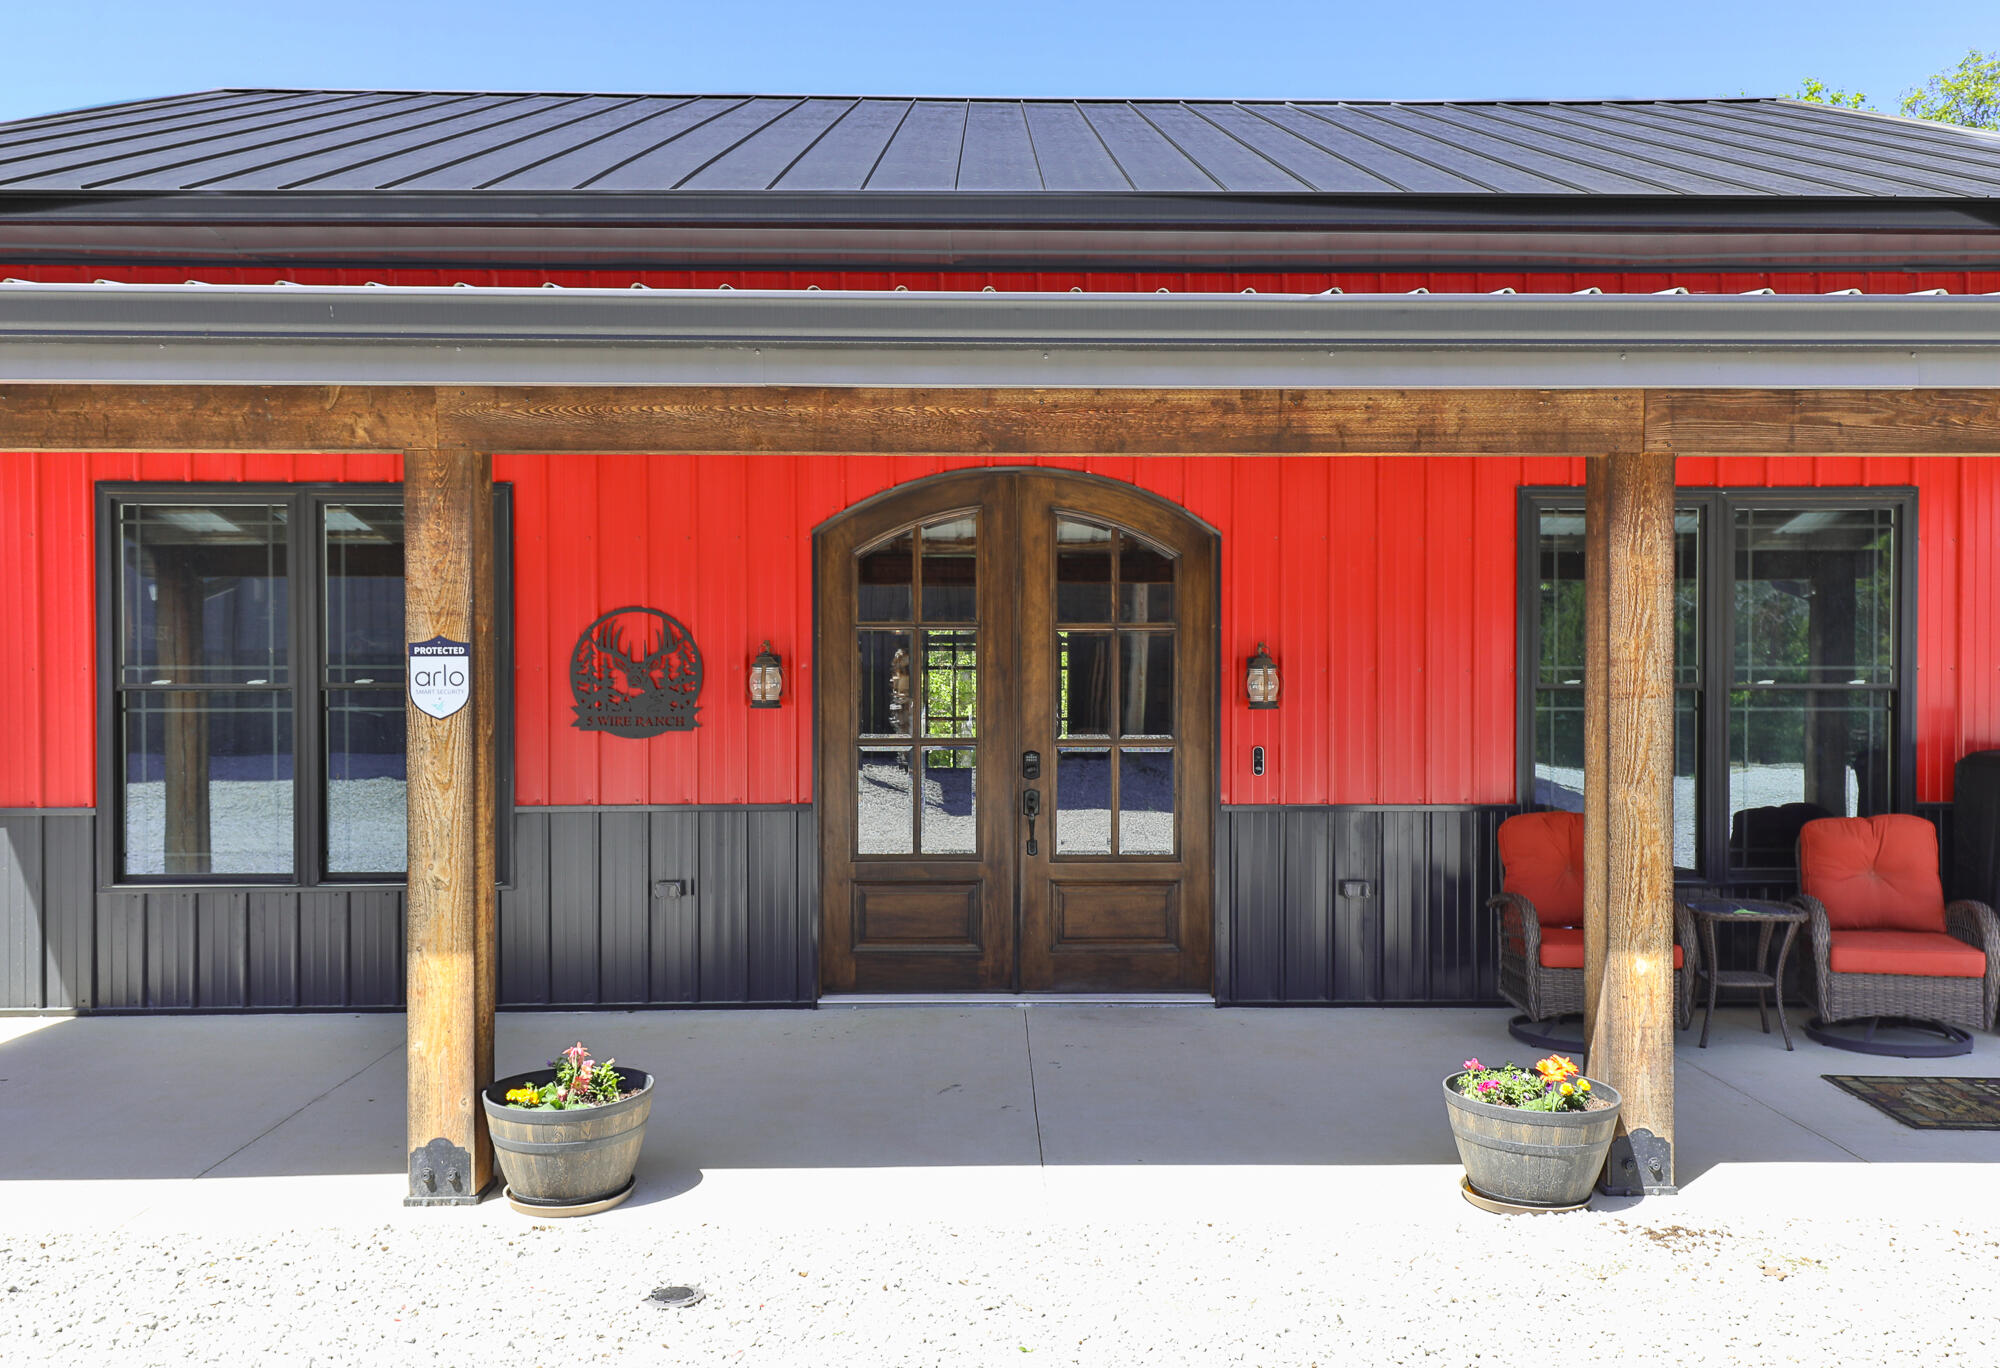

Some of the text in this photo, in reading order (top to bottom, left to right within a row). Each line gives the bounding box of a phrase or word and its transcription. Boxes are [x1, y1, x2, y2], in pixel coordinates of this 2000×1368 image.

[414, 646, 465, 655] PROTECTED
[415, 664, 464, 687] arlo
[586, 716, 685, 727] 5 WIRE RANCH
